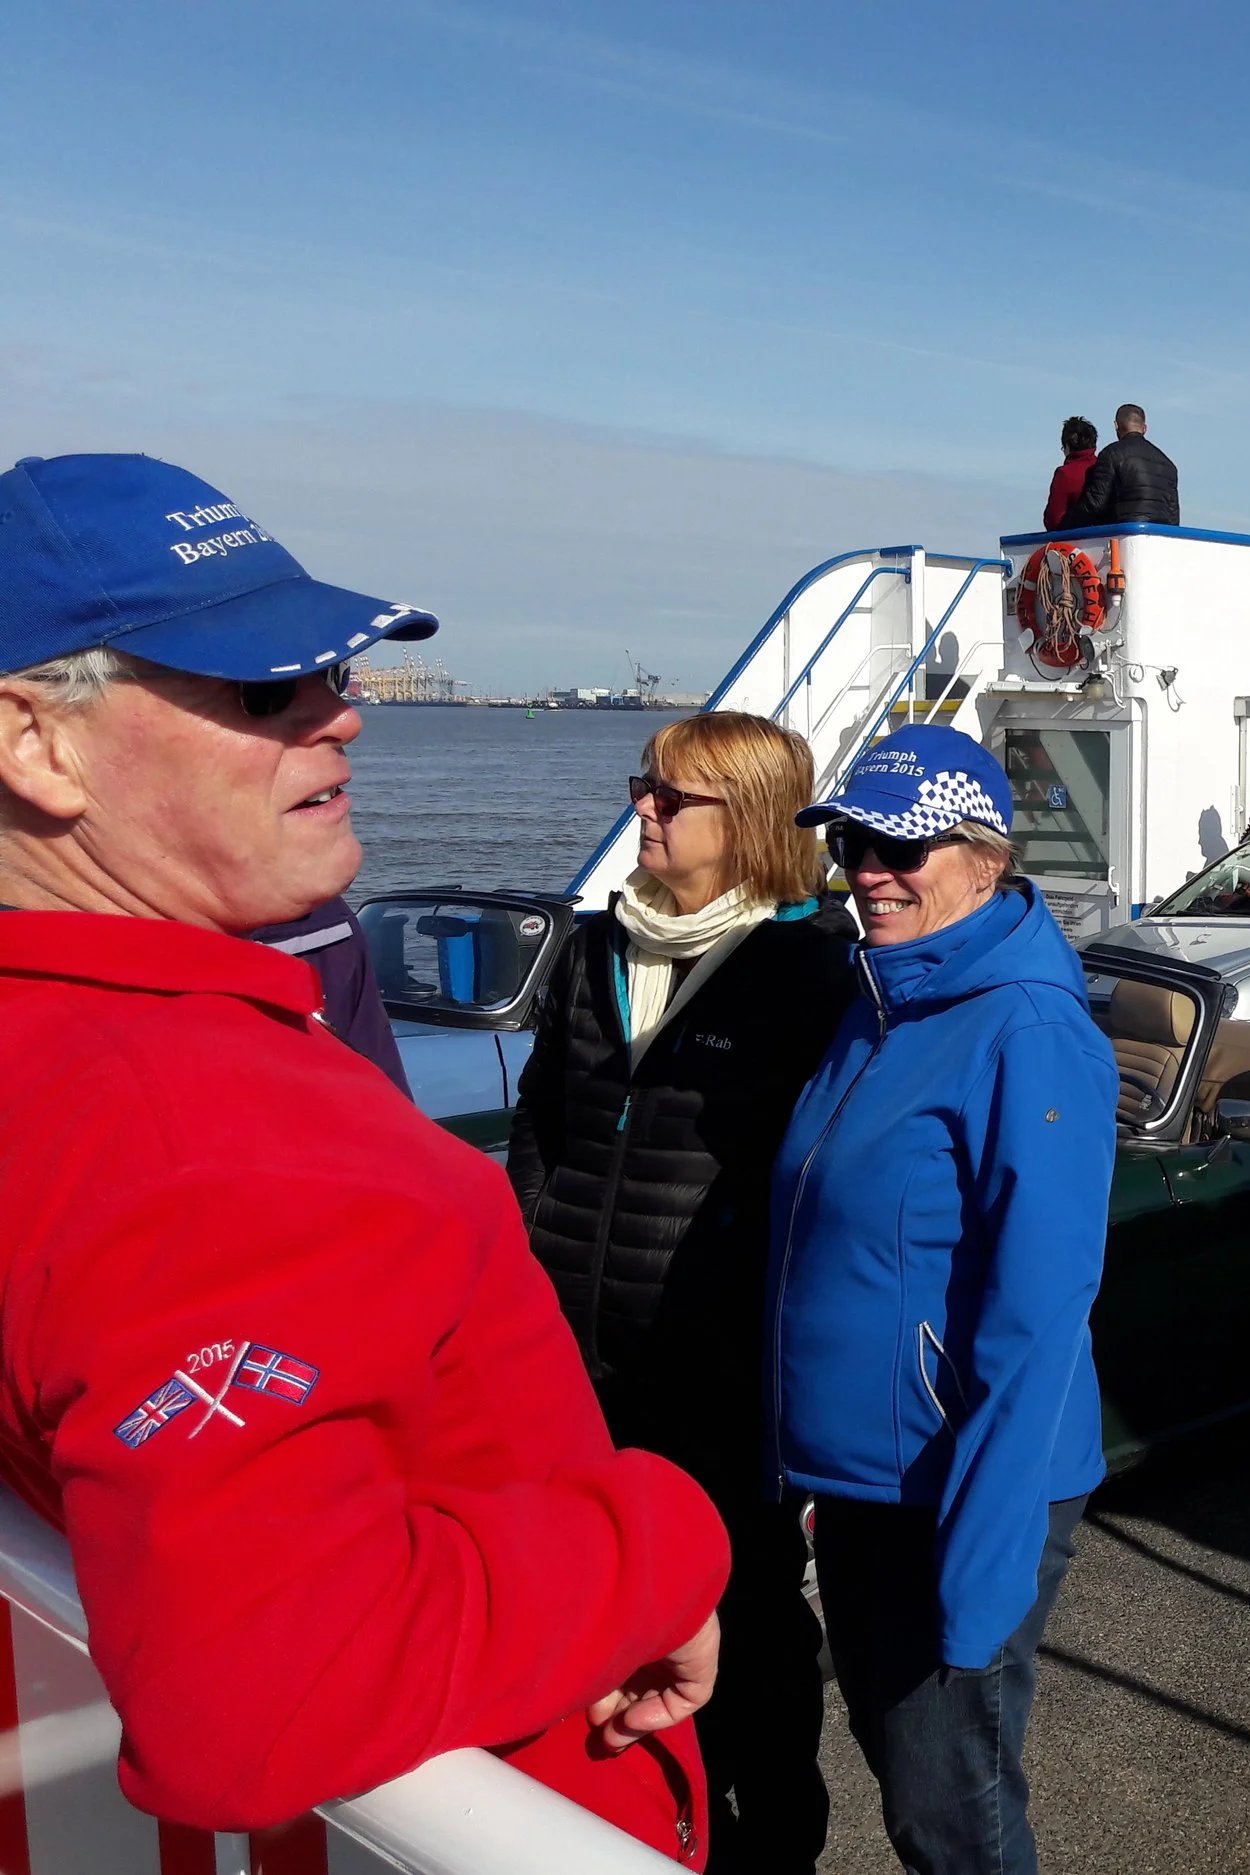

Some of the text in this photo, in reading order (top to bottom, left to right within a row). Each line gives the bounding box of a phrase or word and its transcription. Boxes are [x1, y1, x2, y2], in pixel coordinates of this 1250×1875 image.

[170, 529, 258, 565] Bayern
[868, 750, 917, 763] Triumph
[890, 762, 926, 777] 2015
[705, 1034, 732, 1050] Rab
[187, 1338, 236, 1374] 2015
